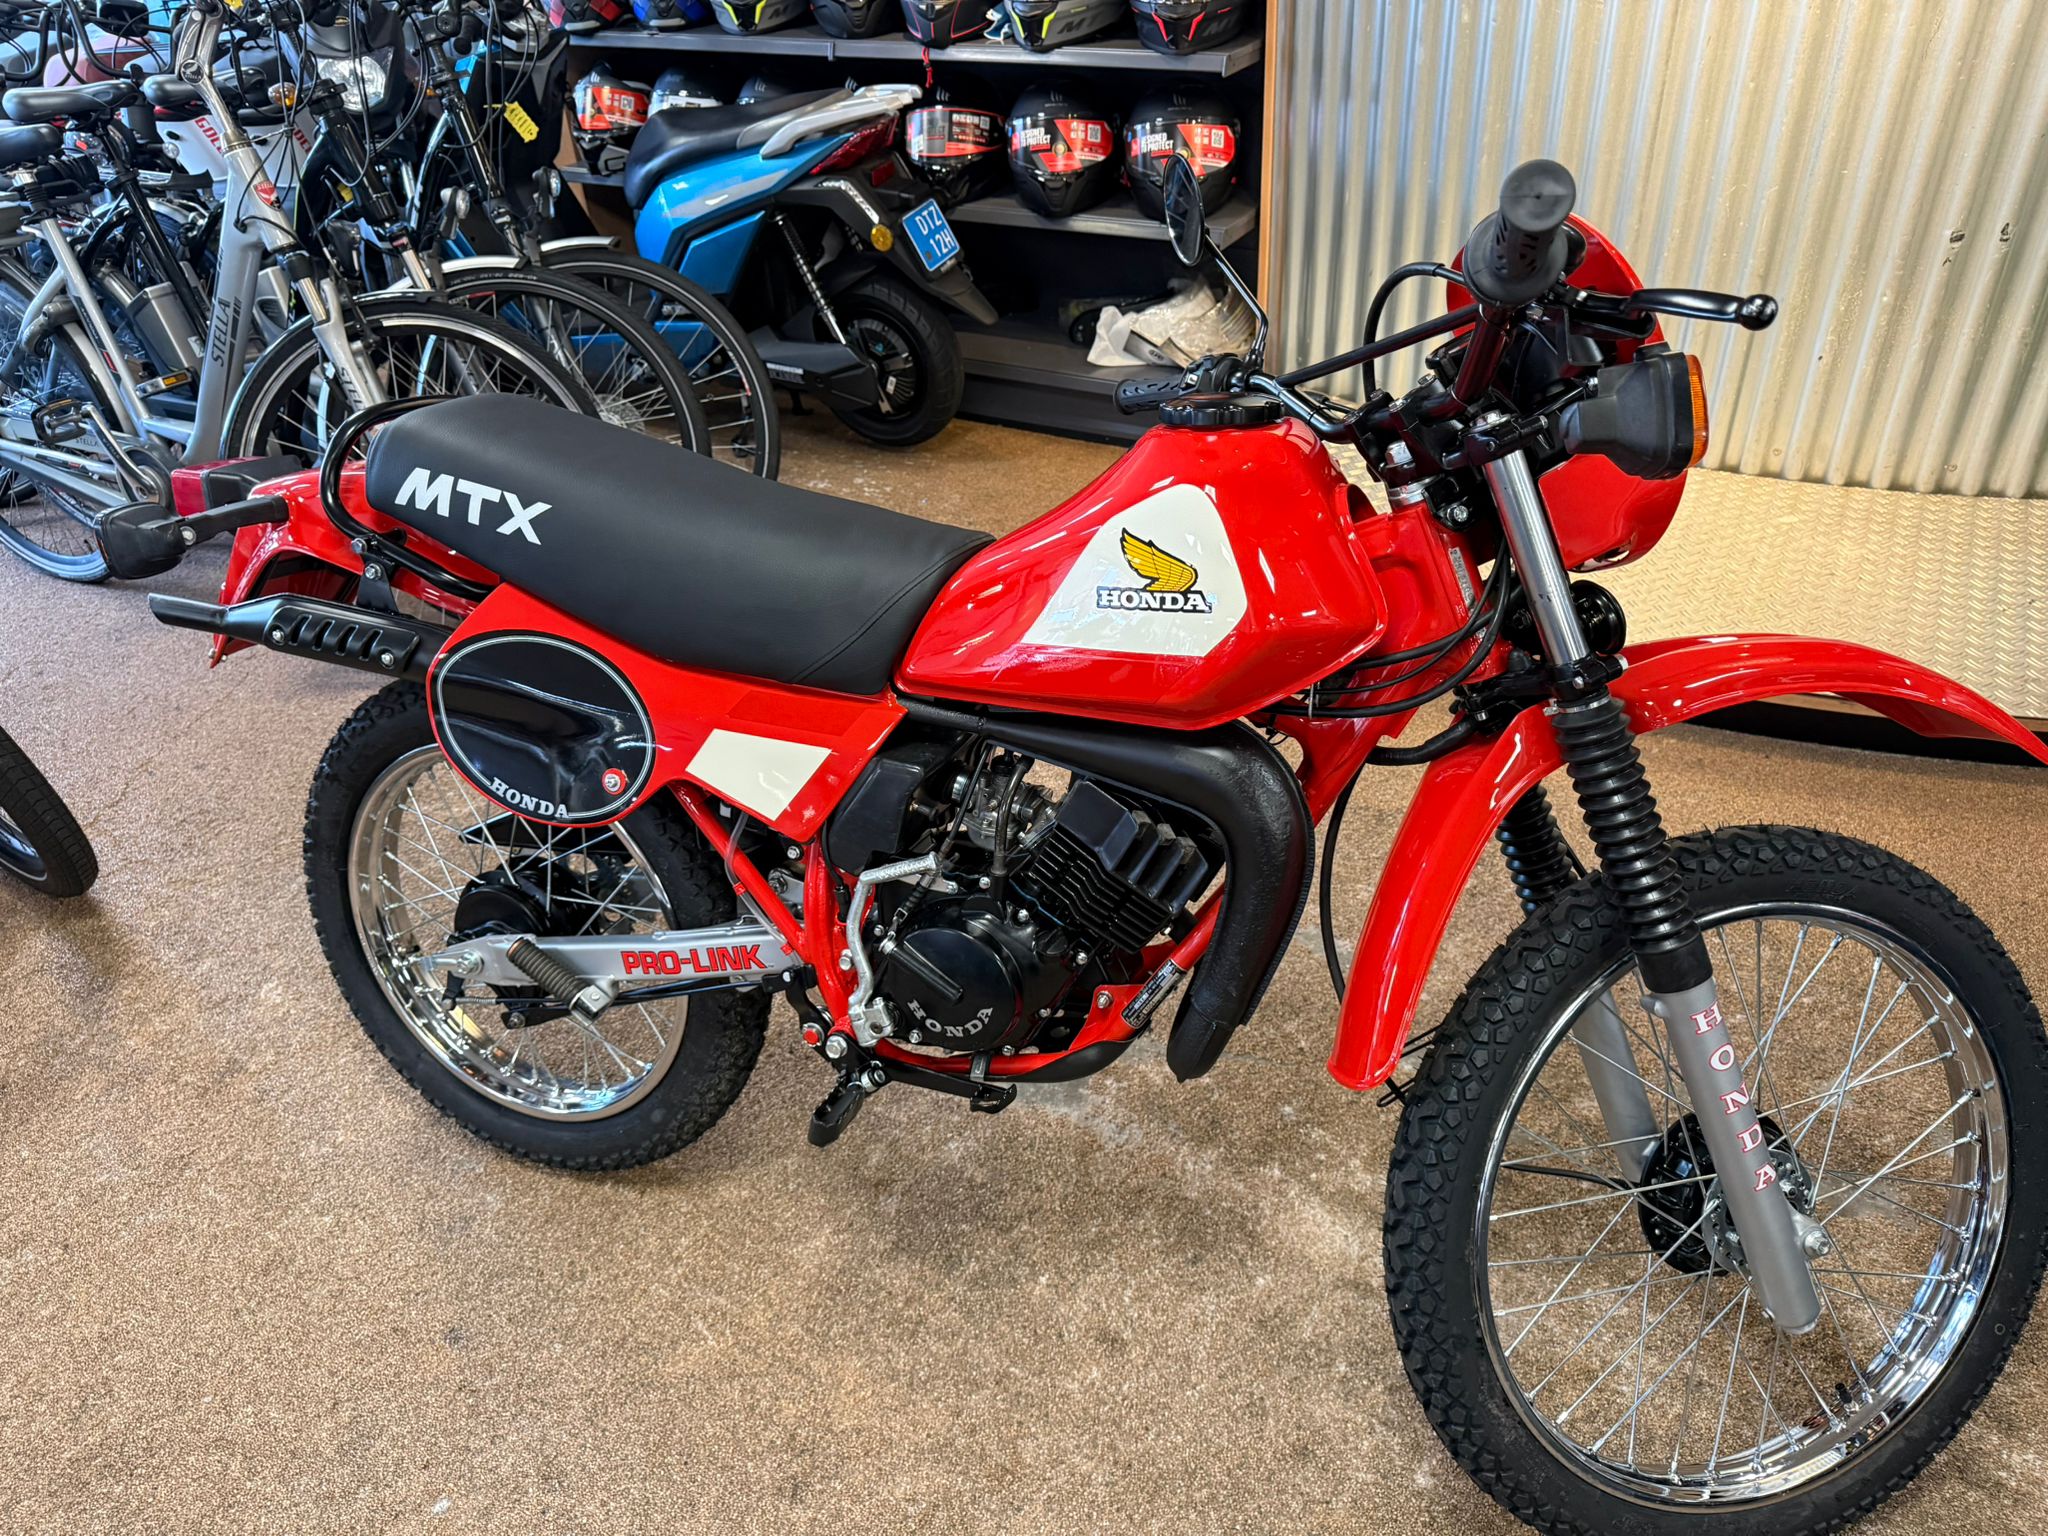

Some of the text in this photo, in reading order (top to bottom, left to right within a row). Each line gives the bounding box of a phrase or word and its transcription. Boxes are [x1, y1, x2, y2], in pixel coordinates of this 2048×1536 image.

[914, 205, 943, 236] DTZ
[929, 228, 955, 257] 12H
[211, 297, 232, 368] STELLA
[394, 467, 553, 546] MTX
[1097, 587, 1212, 613] HONDA
[489, 776, 570, 820] HONDA
[620, 944, 768, 976] PRO-LINK
[906, 998, 995, 1039] HONDA
[1689, 999, 1778, 1193] HONDA
